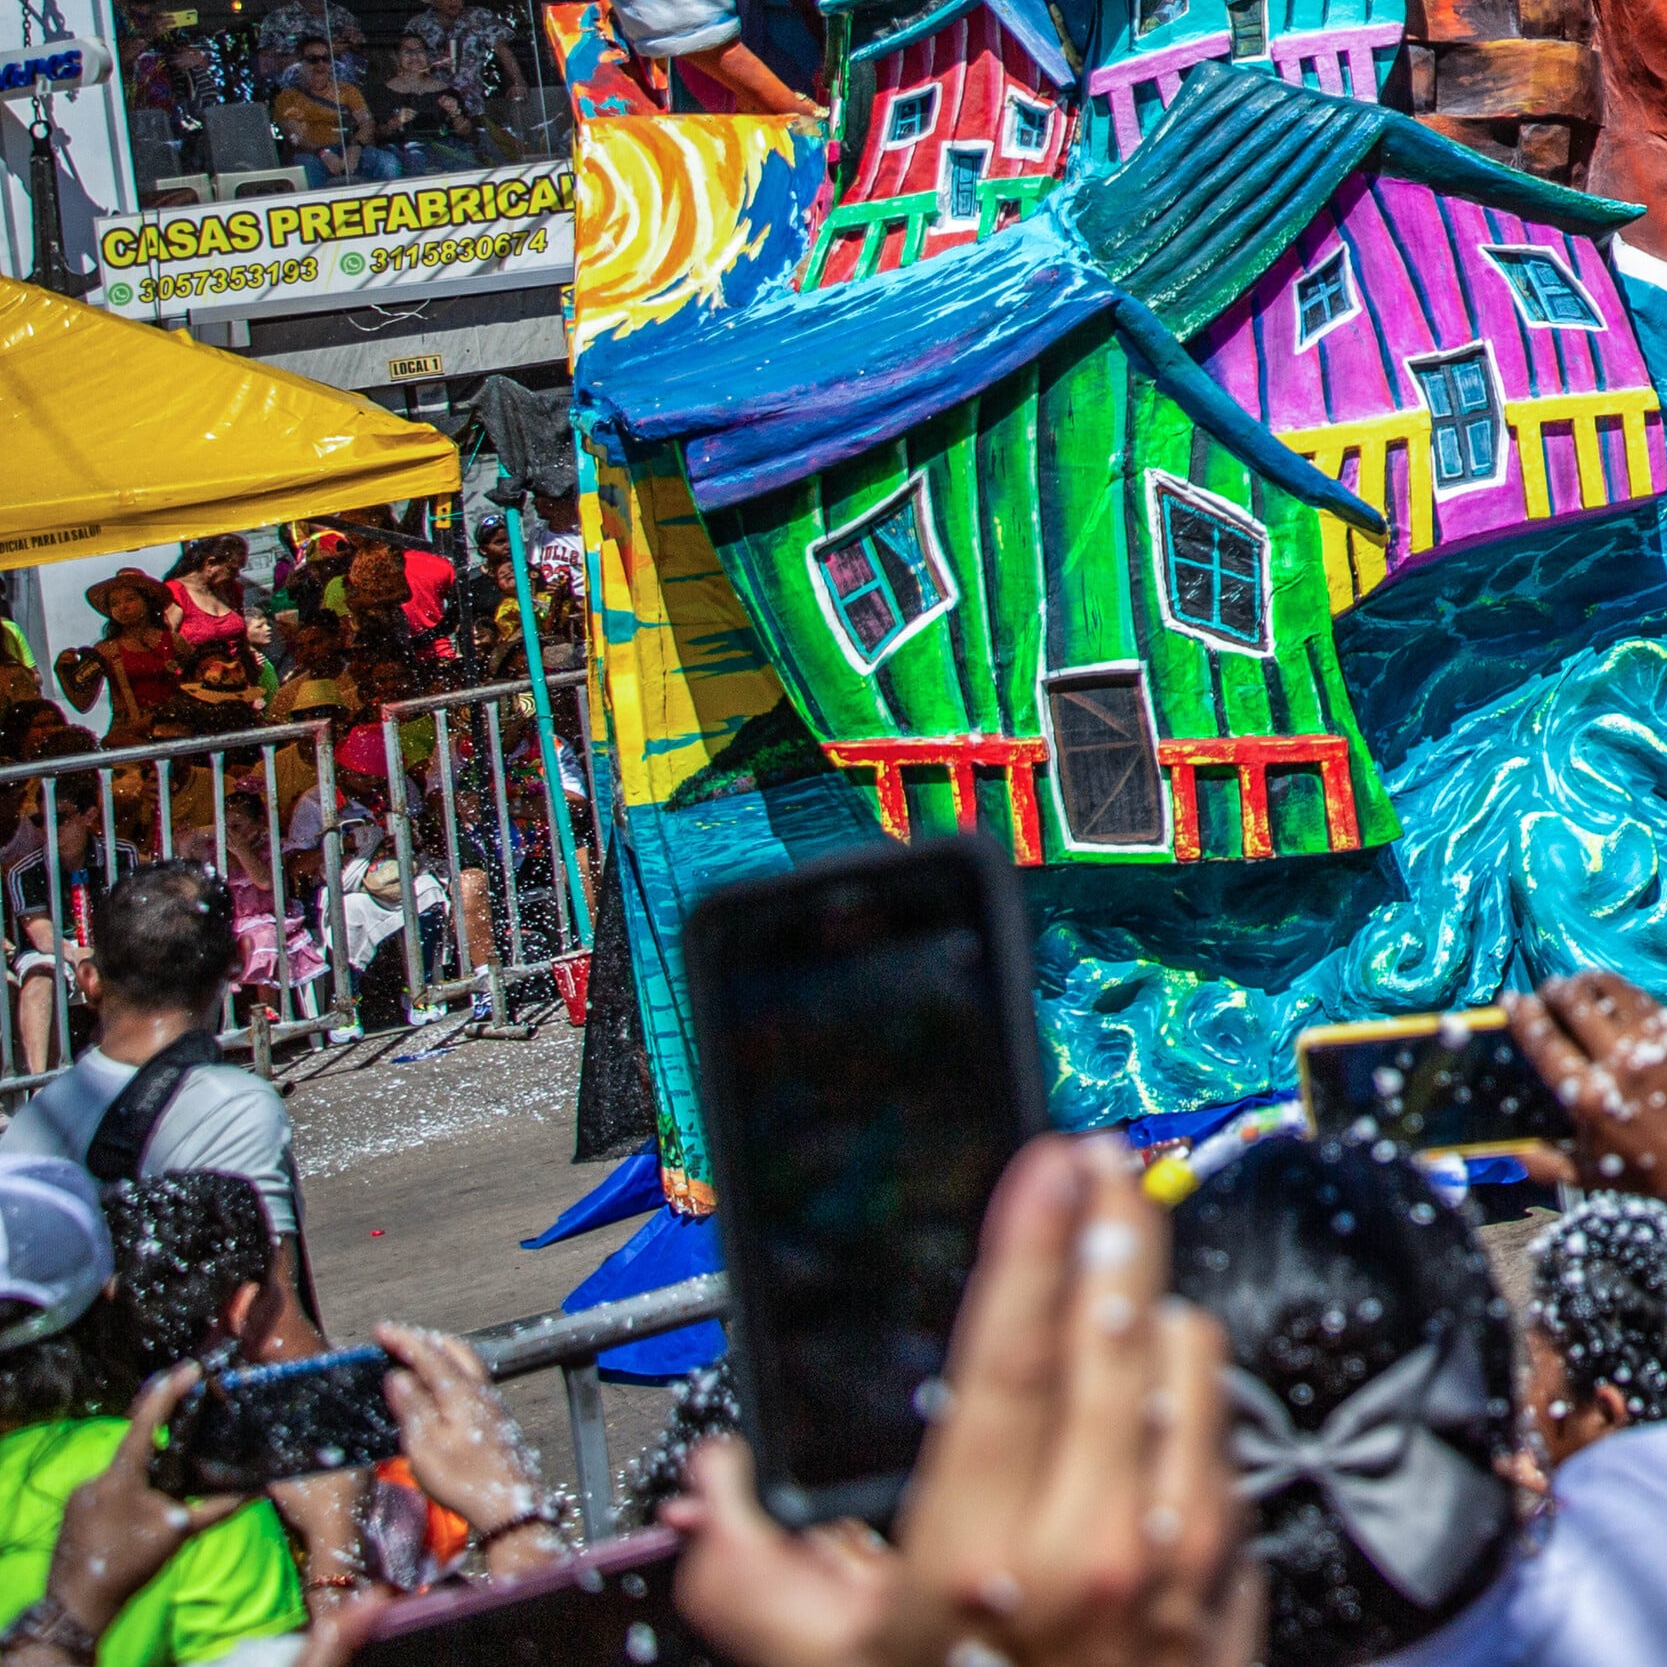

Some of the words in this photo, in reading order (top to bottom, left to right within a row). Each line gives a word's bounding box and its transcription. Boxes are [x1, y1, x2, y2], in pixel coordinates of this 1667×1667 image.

[102, 211, 262, 270] CASAS
[370, 228, 548, 273] 3115830674
[139, 255, 319, 303] 3057353193
[393, 359, 430, 376] LOCAL
[31, 532, 57, 549] PARA
[57, 530, 71, 544] LA
